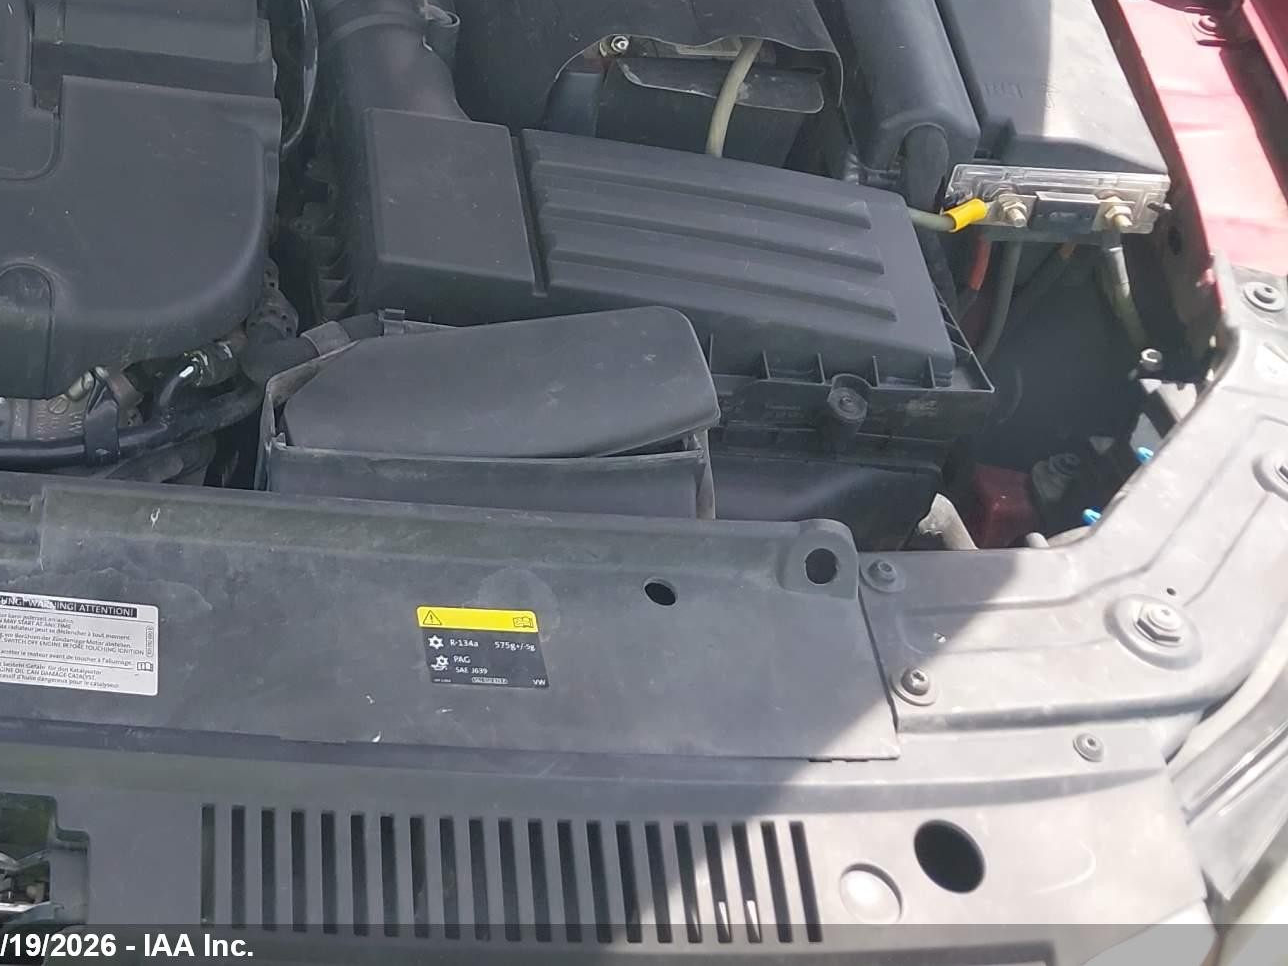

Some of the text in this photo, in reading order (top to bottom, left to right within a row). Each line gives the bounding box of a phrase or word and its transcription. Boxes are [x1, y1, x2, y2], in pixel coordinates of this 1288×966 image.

[78, 603, 133, 615] ATTENTION!
[450, 639, 479, 647] R-134a
[453, 655, 471, 664] PAG
[472, 667, 488, 675] J639
